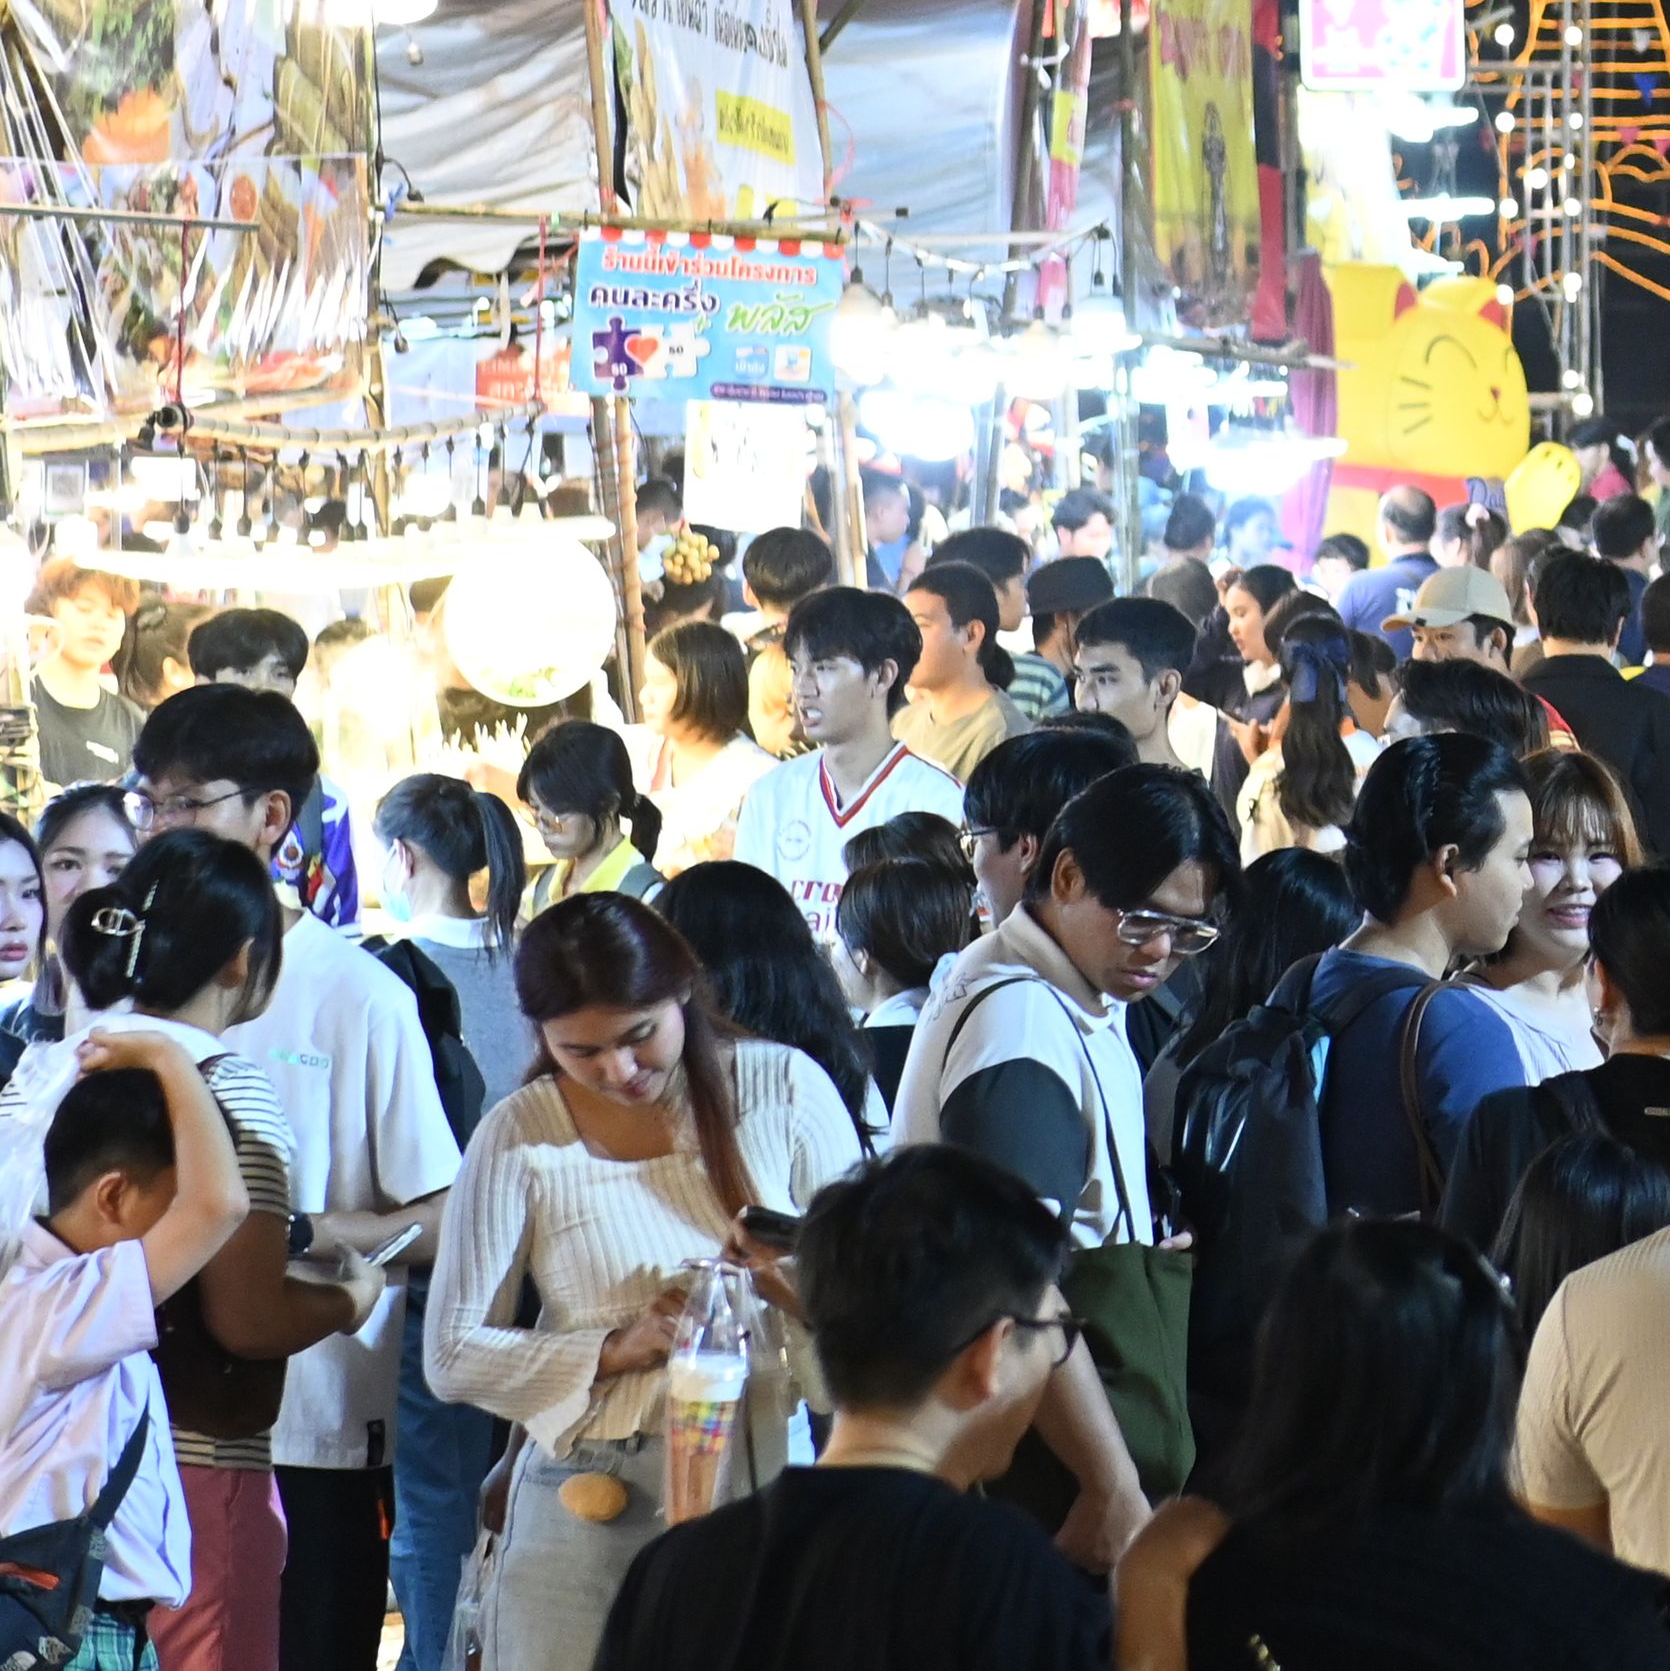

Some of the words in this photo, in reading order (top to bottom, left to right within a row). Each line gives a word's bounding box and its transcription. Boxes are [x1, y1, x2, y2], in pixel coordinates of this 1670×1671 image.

[604, 246, 816, 283] ร้านนี้เข้าร่วมโครงการ
[590, 279, 718, 313] คนละครึ่ง
[727, 293, 834, 334] พลัส
